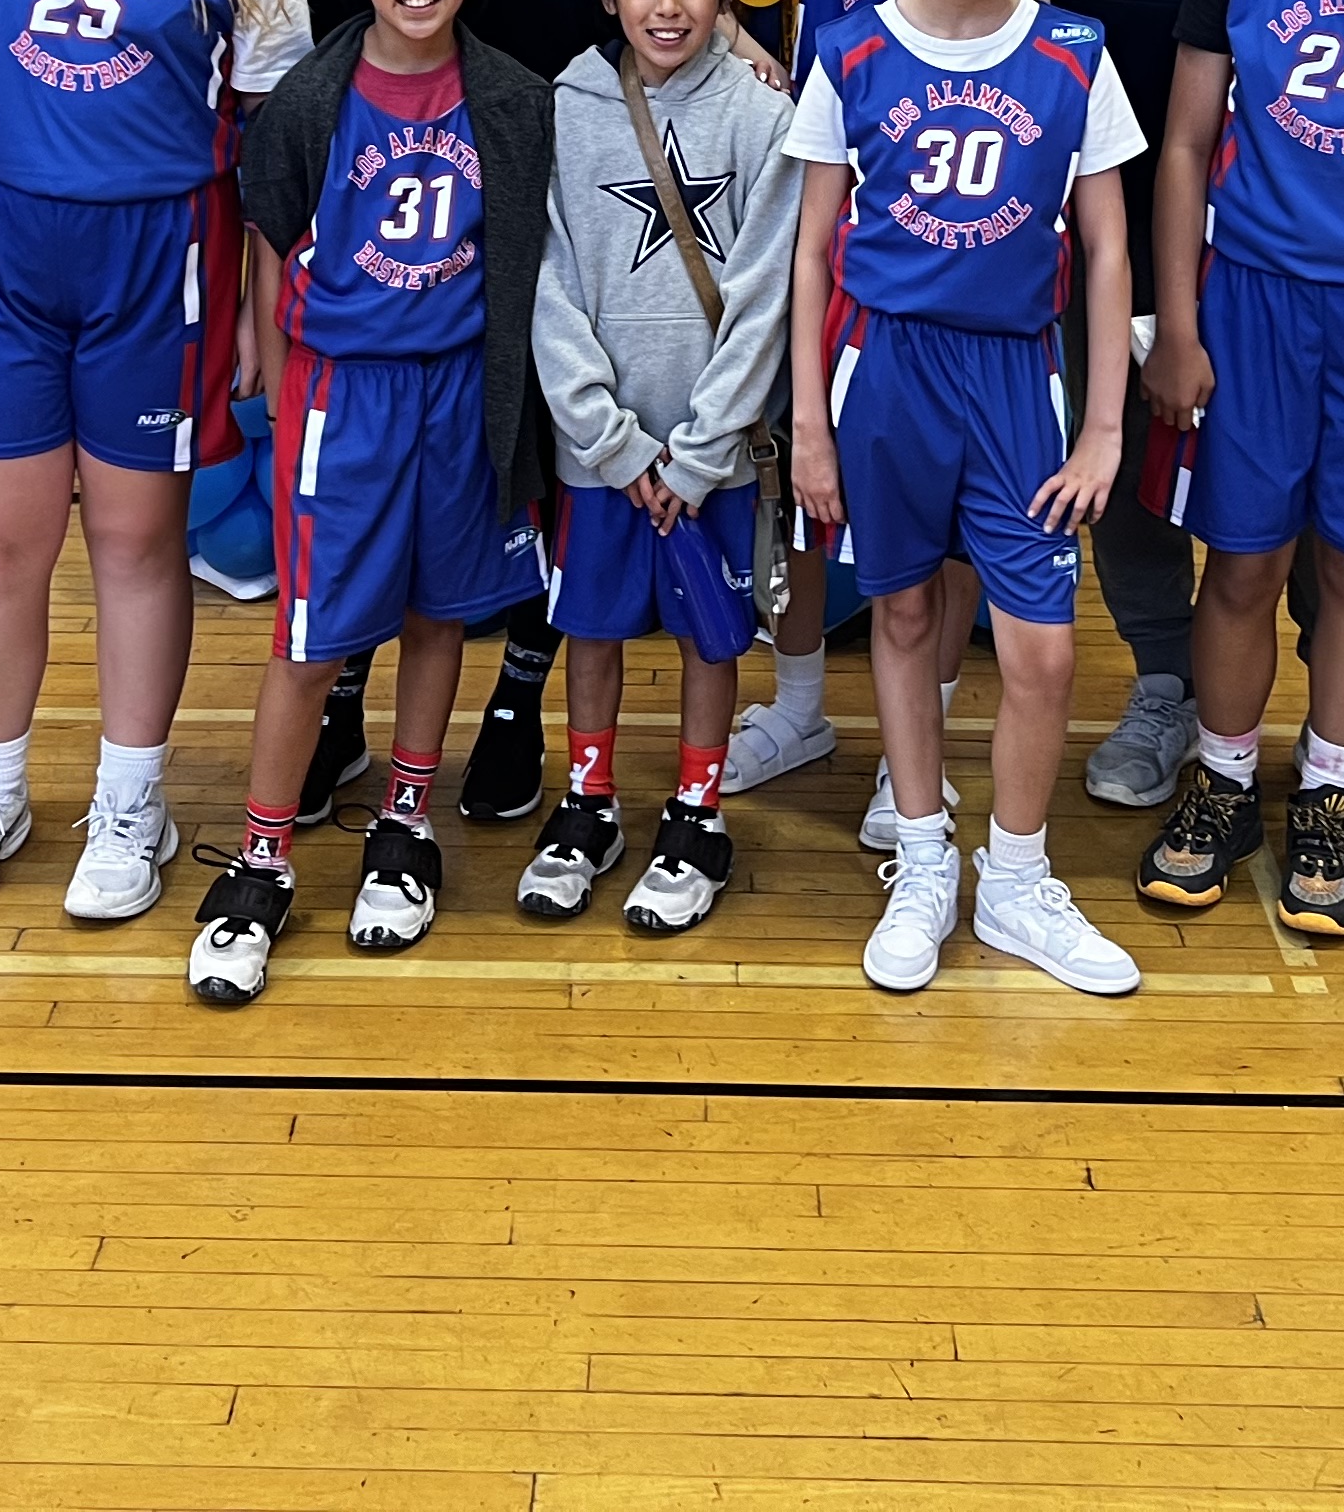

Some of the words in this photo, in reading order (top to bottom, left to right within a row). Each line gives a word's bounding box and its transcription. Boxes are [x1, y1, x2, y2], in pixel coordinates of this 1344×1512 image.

[1267, 1, 1313, 43] LOS
[8, 29, 154, 92] BASKETBALL
[879, 97, 921, 143] LOS
[926, 80, 1043, 146] ALAMITOS
[348, 144, 386, 190] LOS
[908, 128, 1005, 198] 30
[378, 174, 455, 241] 31
[887, 193, 1033, 250] BASKETBALL
[137, 413, 171, 425] NJB
